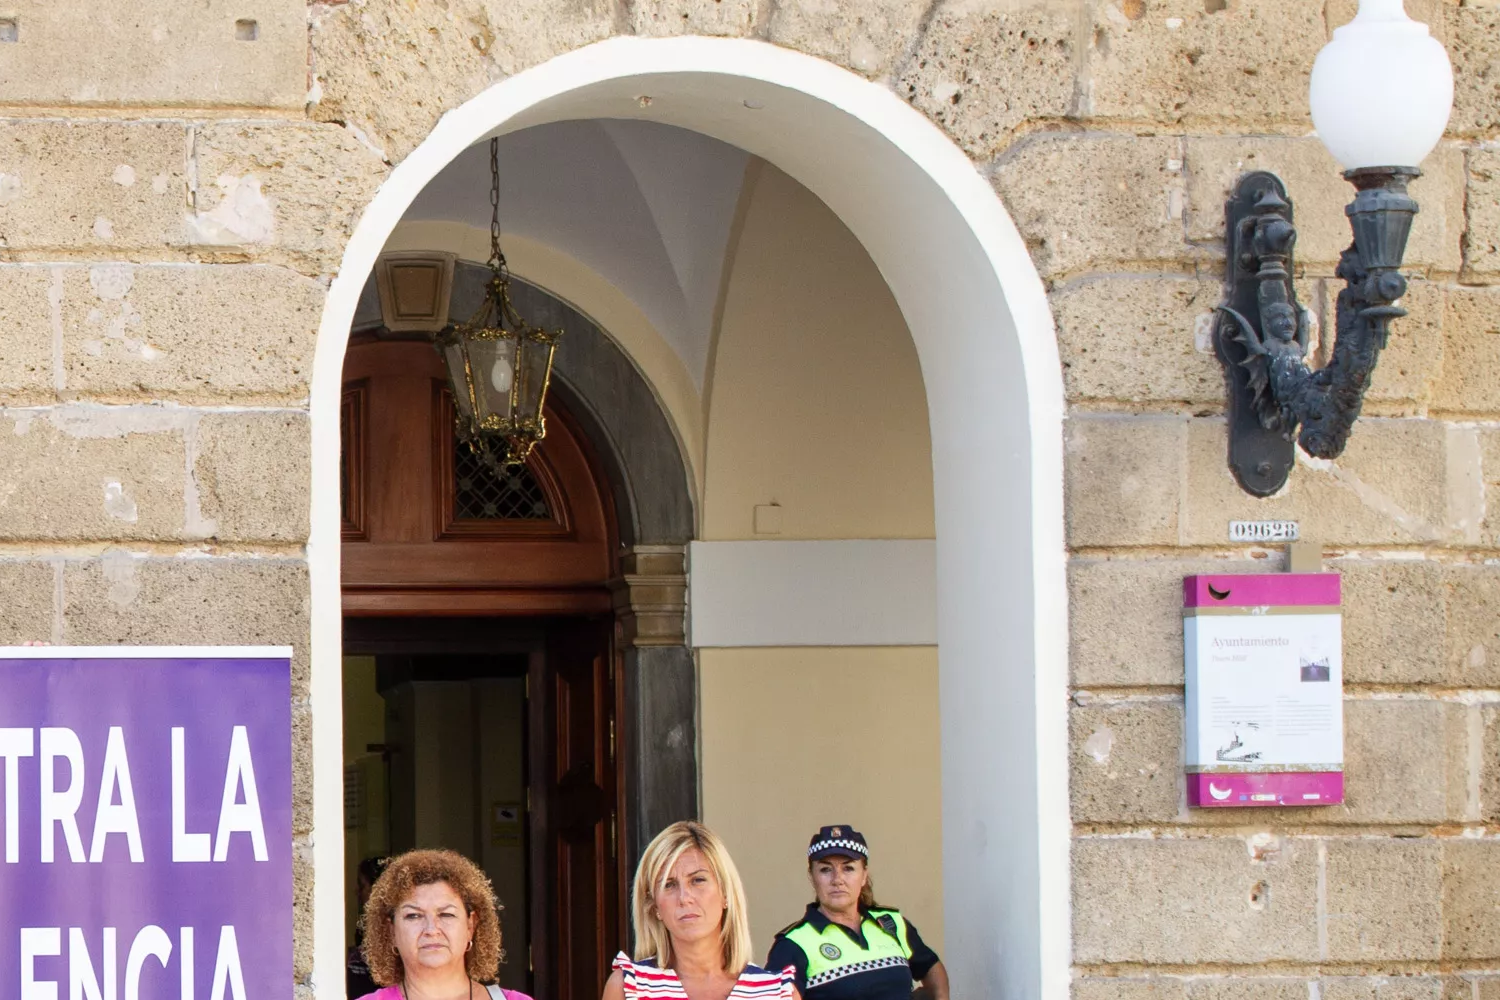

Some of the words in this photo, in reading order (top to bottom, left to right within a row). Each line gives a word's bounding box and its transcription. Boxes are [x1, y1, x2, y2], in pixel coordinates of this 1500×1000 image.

[1234, 523, 1296, 537] 09628
[1211, 636, 1290, 650] Ayuntamiento
[171, 725, 269, 863] LA
